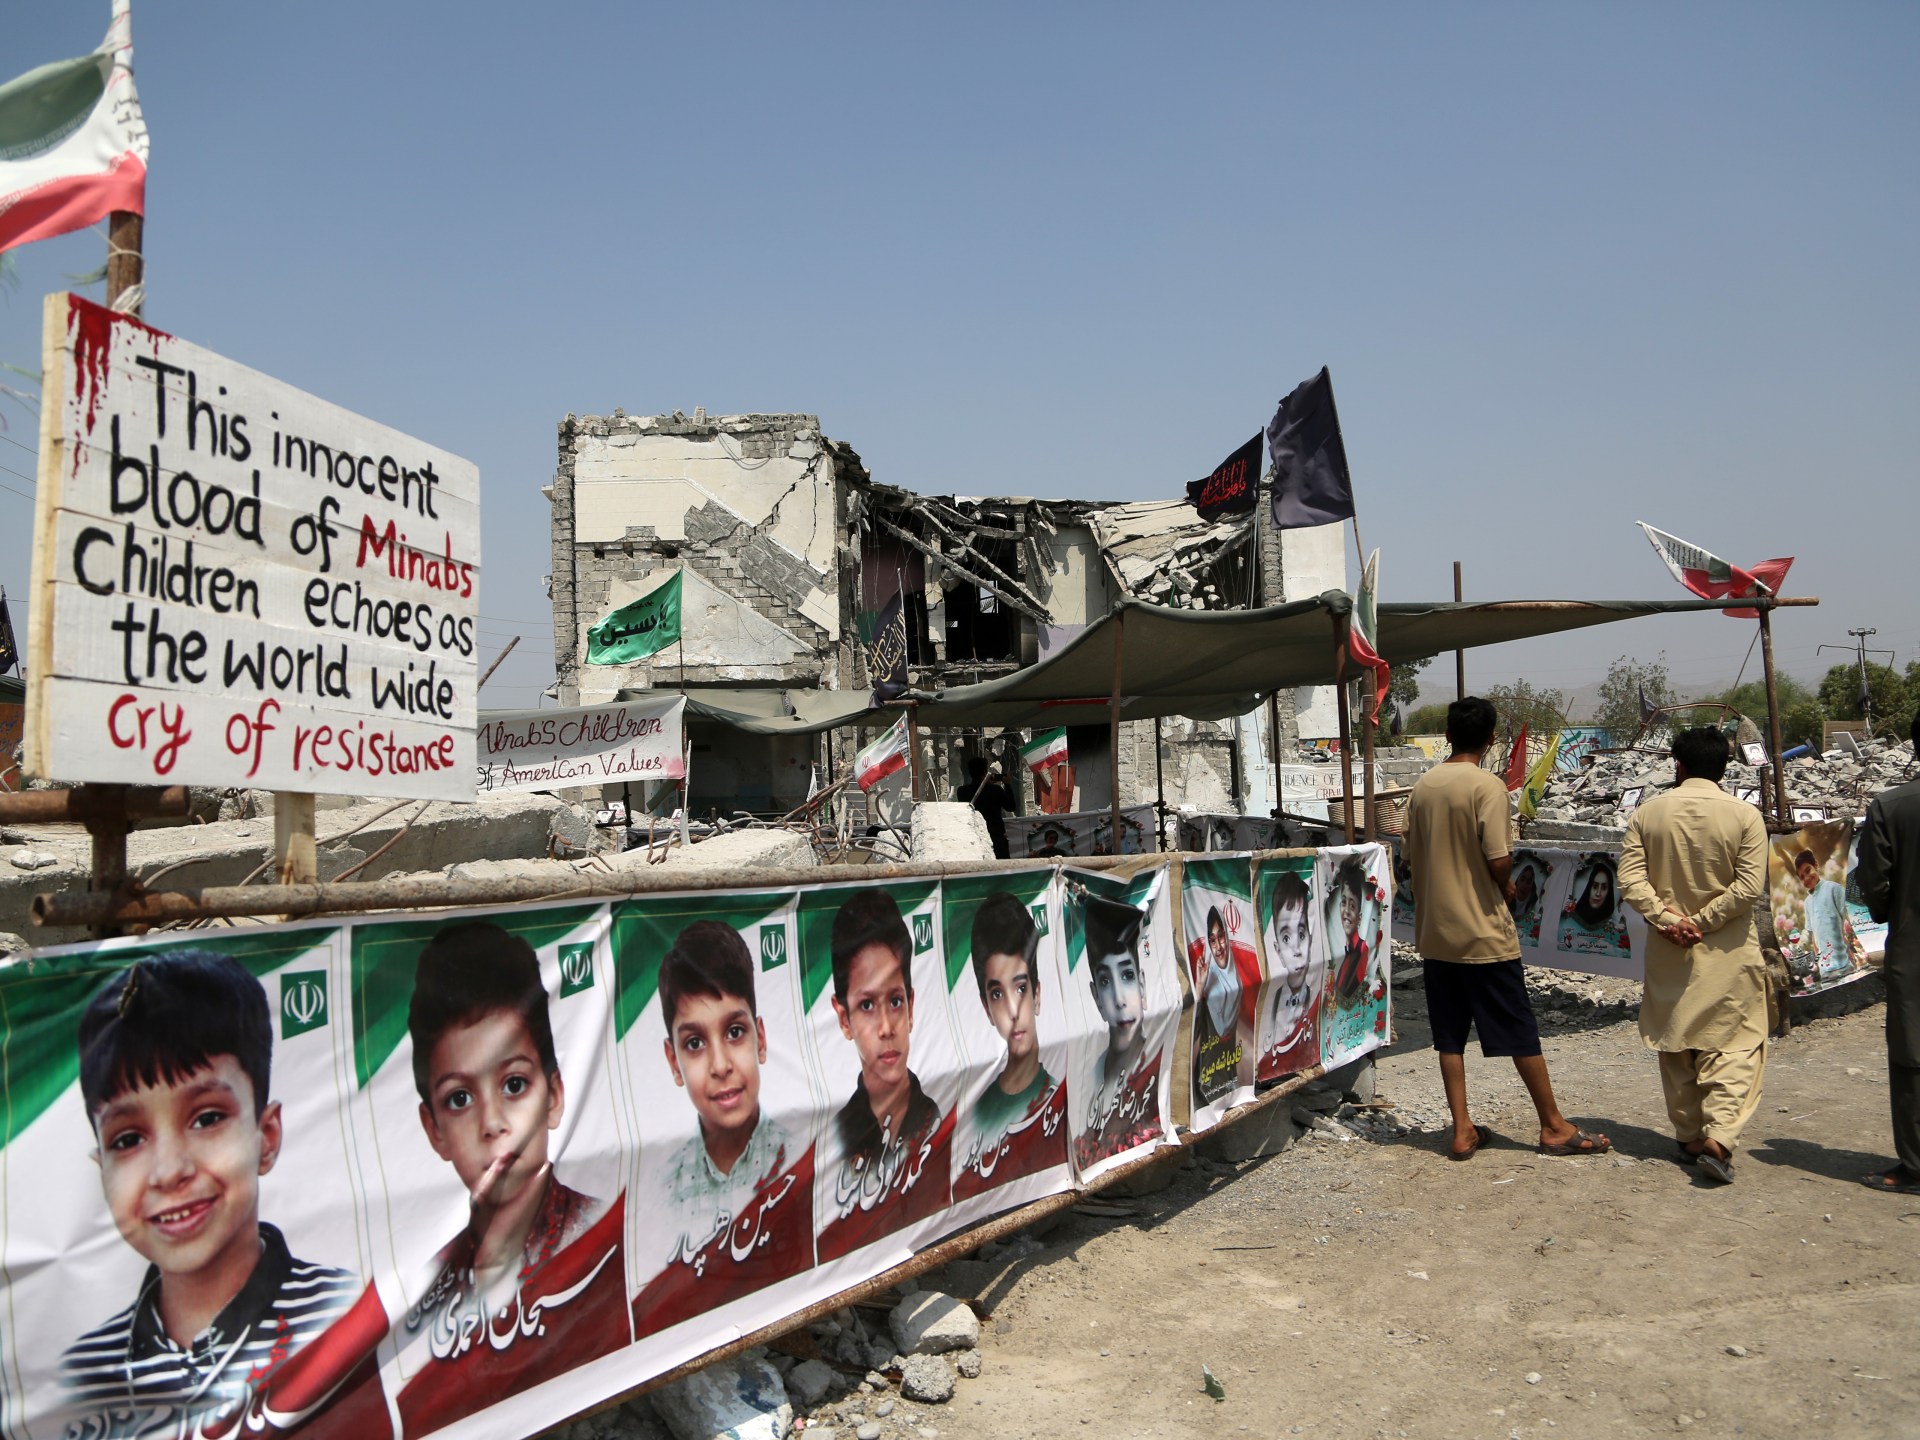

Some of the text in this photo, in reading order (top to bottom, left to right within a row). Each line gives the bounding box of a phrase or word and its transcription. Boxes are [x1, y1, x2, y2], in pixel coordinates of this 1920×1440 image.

[136, 355, 439, 519] This innocent
[110, 414, 472, 597] blood of Minabs
[73, 522, 473, 656] Children echoes as
[111, 602, 453, 719] the world wide
[108, 694, 192, 775] Cry
[226, 698, 281, 778] of
[293, 720, 455, 776] resistance
[559, 708, 662, 746] Children
[599, 749, 662, 776] Values
[1269, 774, 1318, 786] EIDENCE
[1324, 774, 1337, 785] OF
[901, 1117, 941, 1195] محمد
[980, 1085, 1059, 1178] حسین
[731, 1174, 797, 1262] حسین
[430, 1292, 486, 1359] احمدی
[489, 1244, 617, 1350] سبحان
[246, 1315, 295, 1395] شهید
